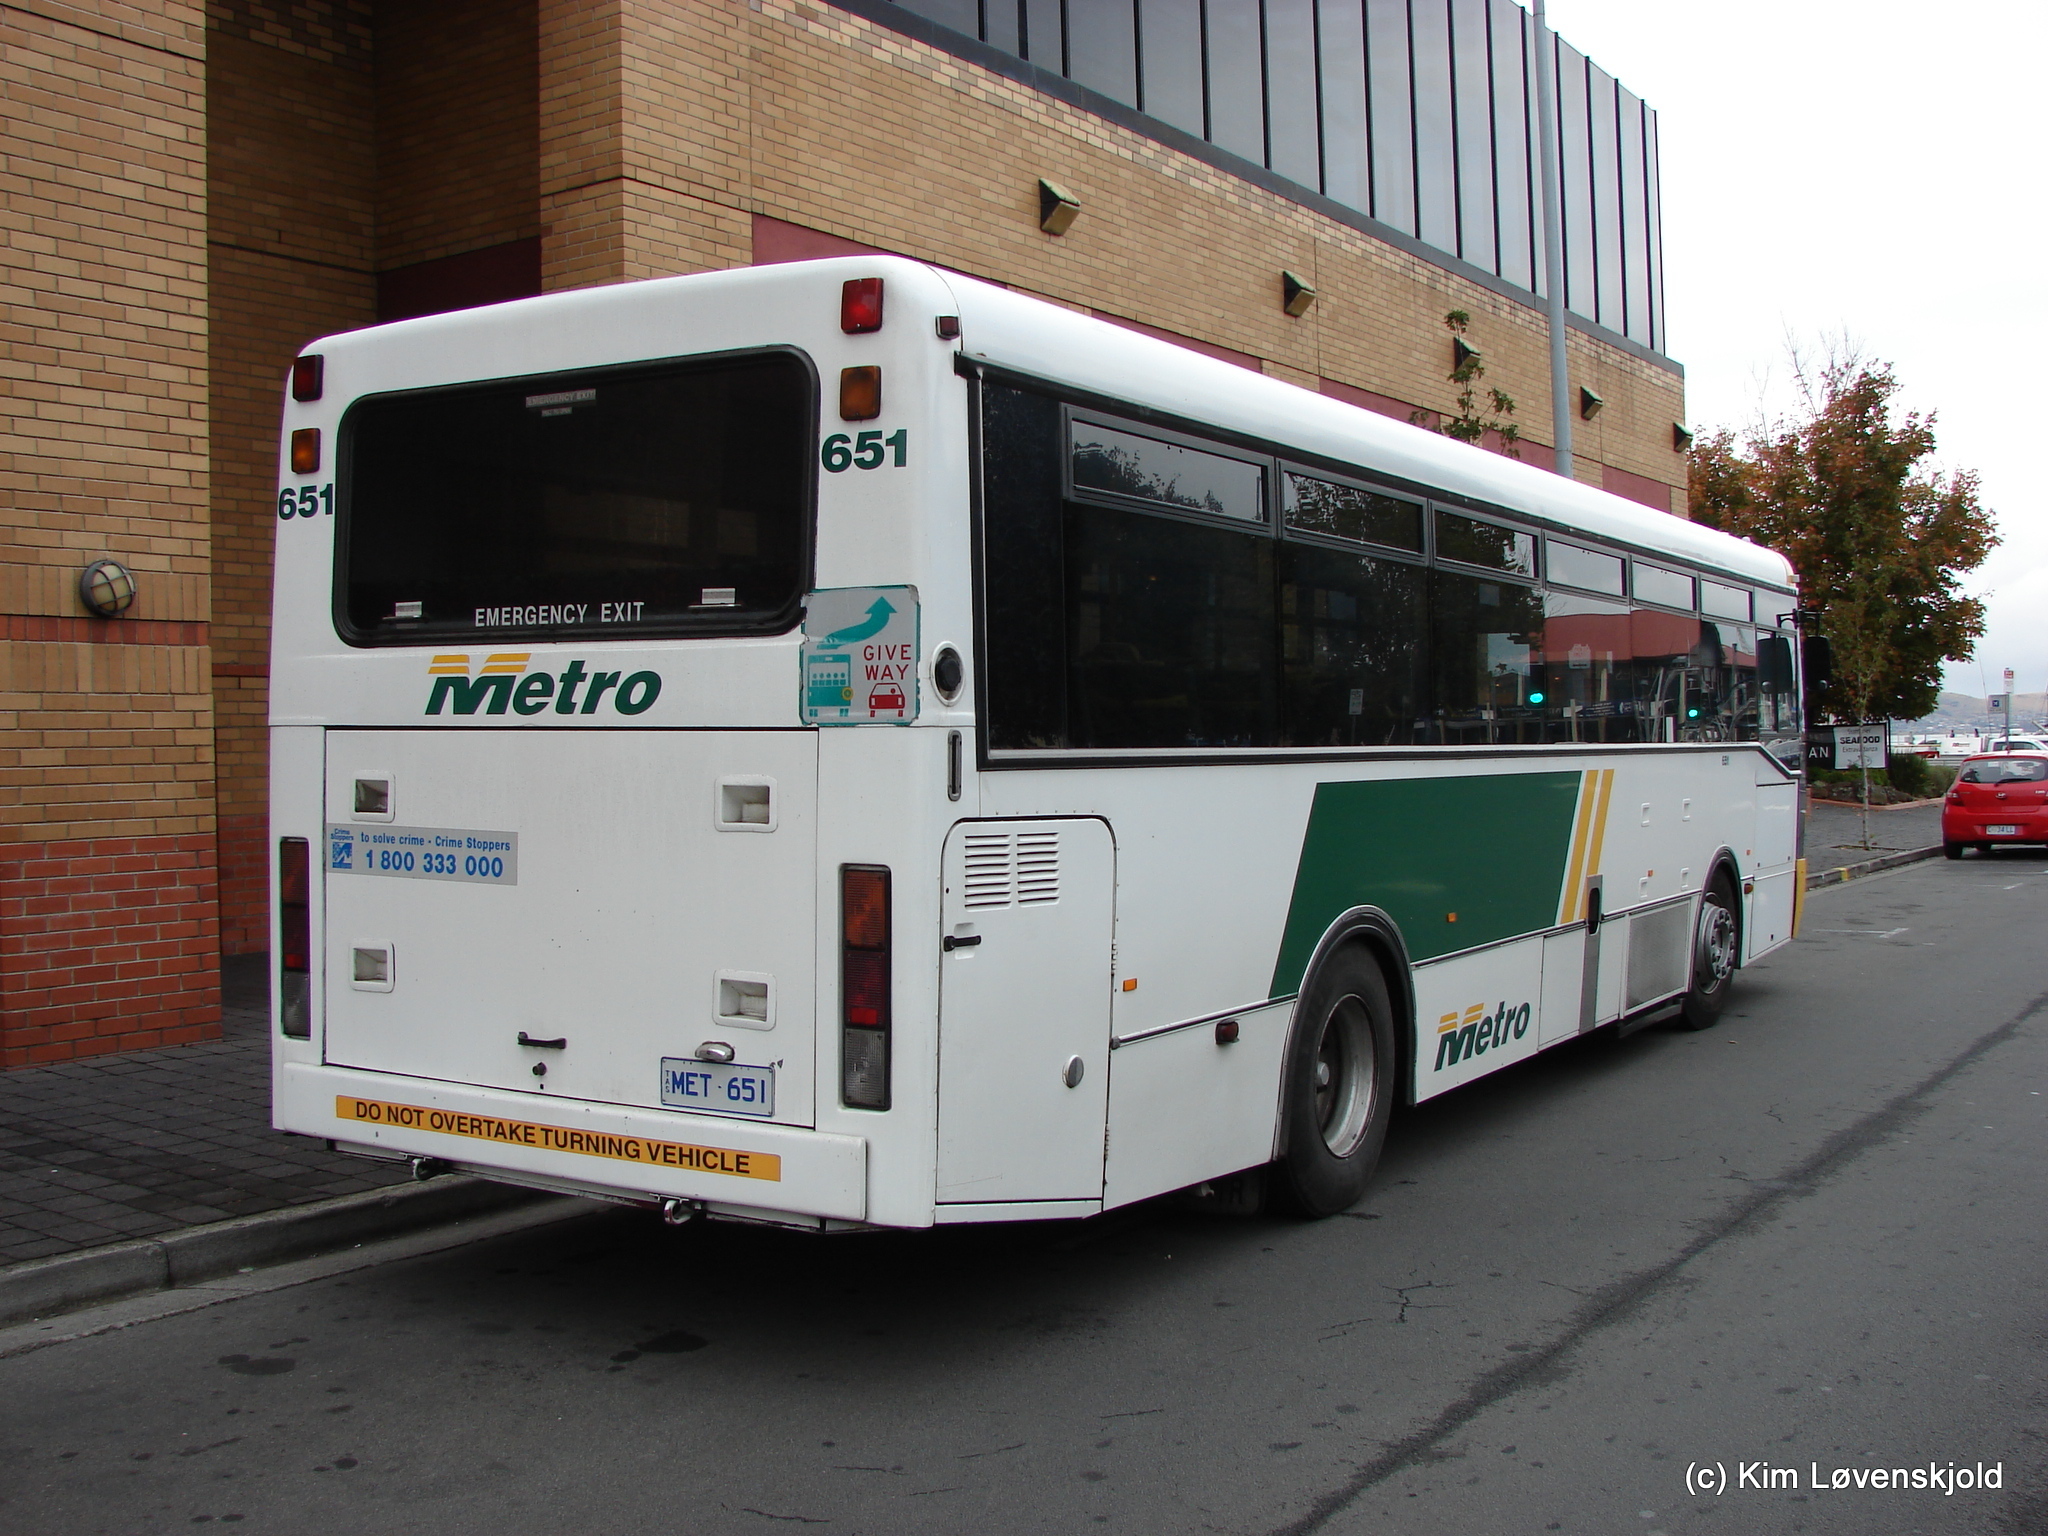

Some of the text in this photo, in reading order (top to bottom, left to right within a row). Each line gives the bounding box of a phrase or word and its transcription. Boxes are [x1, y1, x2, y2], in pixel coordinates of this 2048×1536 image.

[821, 429, 908, 473] 651
[278, 483, 334, 520] 651
[474, 602, 645, 627] EMERGENCY EXIT
[863, 644, 912, 661] GIVE
[425, 653, 662, 716] Metro
[864, 664, 910, 681] WAY
[361, 832, 370, 843] to
[373, 832, 396, 845] solve
[399, 834, 425, 846] crime
[435, 835, 463, 848] Crime
[466, 836, 511, 853] Stoppers
[366, 849, 504, 878] 1 800 333 000
[1434, 1001, 1530, 1072] Metro
[671, 1070, 766, 1104] MET 651
[356, 1101, 750, 1174] DO NOT OVERTAKE TURNING VEHICLE
